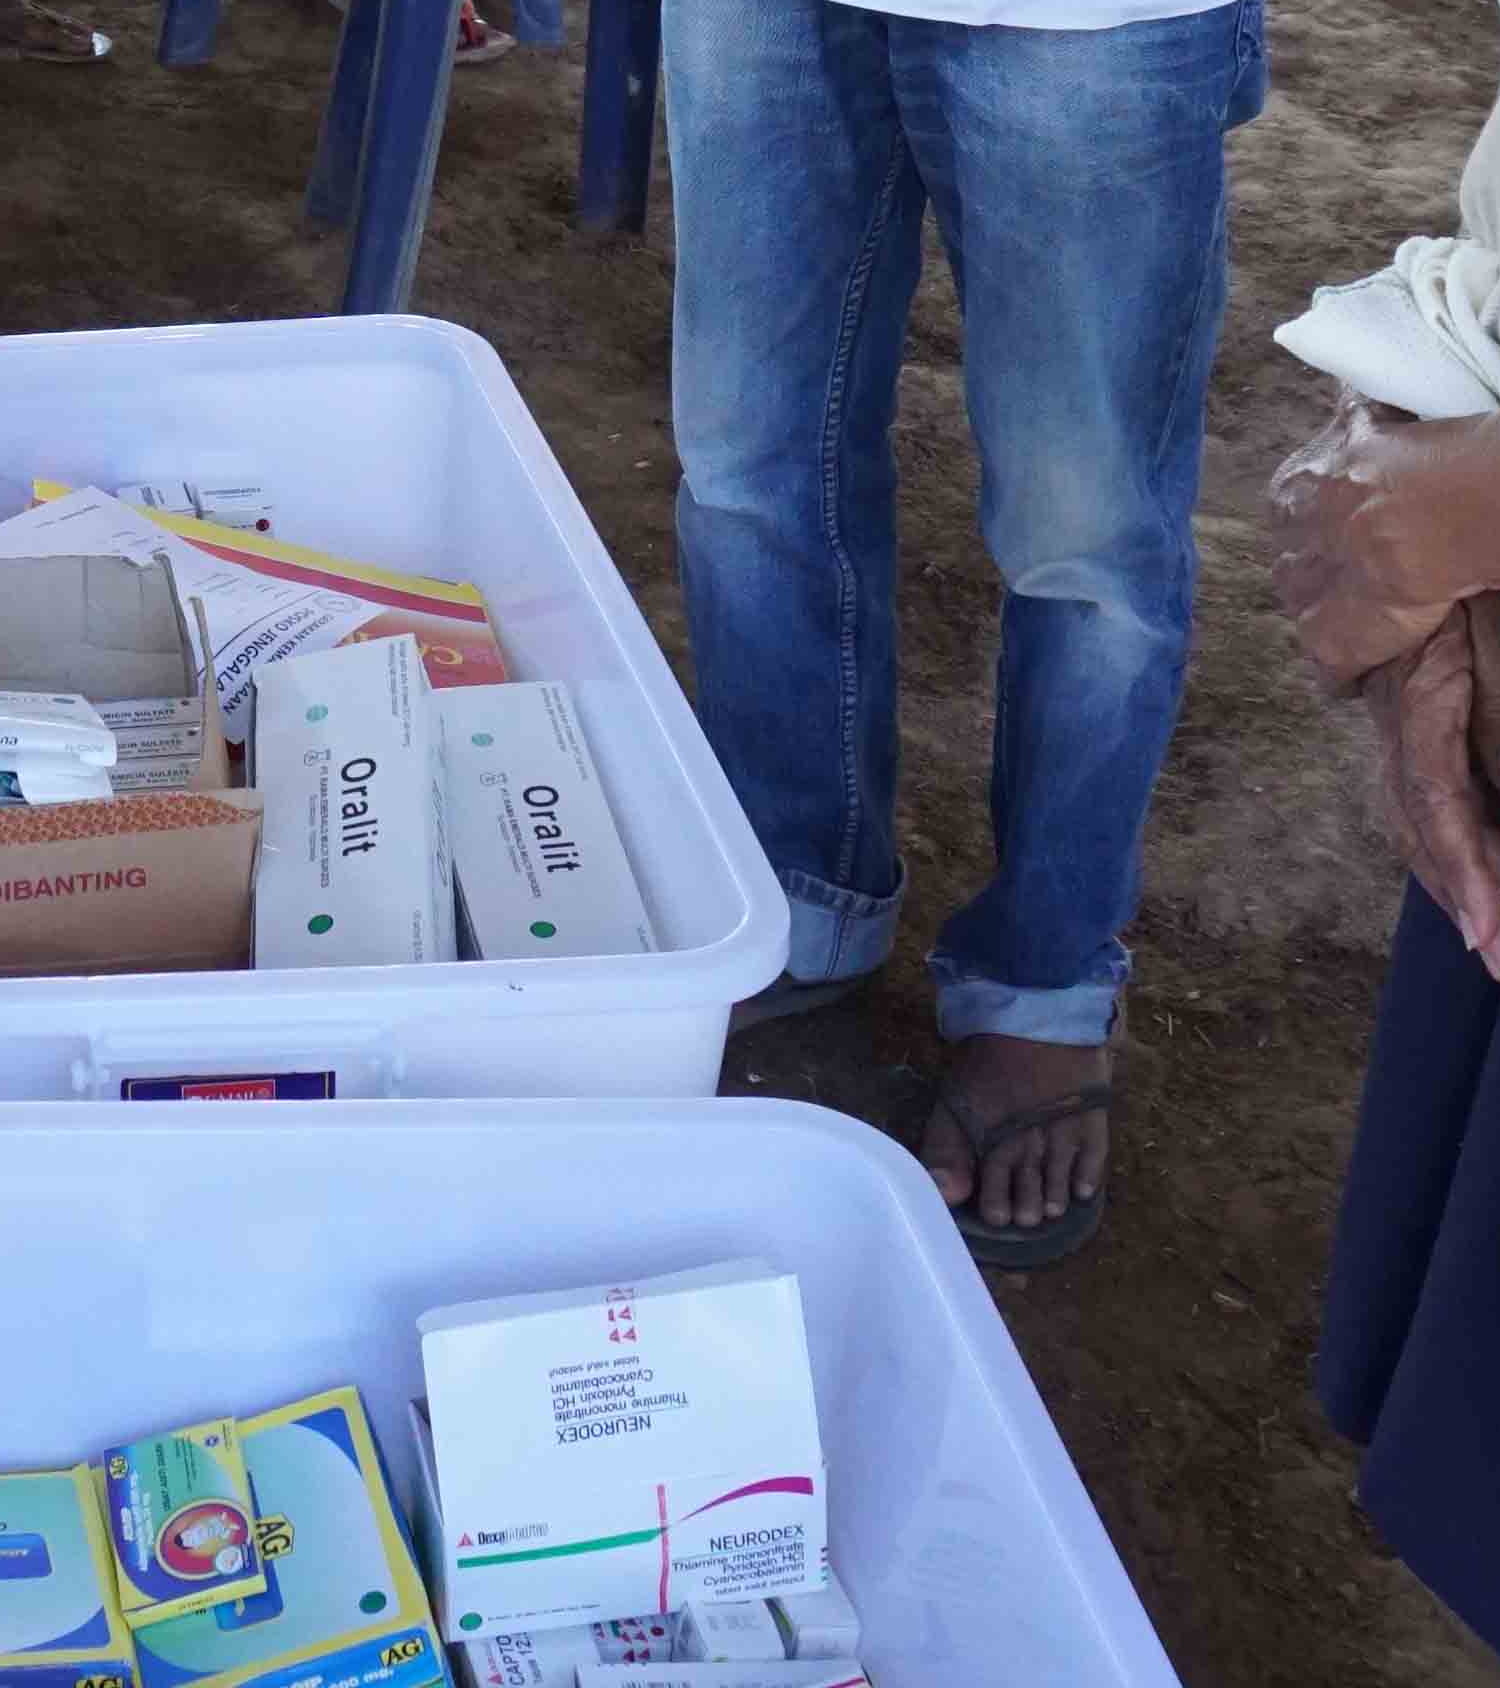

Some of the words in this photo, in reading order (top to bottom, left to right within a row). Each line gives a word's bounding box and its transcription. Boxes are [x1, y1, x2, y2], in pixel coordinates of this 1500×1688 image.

[216, 628, 278, 693] JENGGALA
[341, 758, 378, 856] Oralit
[523, 785, 582, 873] Oralit
[551, 1369, 654, 1394] Cyanocobalamin
[631, 1392, 689, 1406] Thiamine
[556, 1415, 652, 1445] NEURODEX
[709, 1523, 805, 1553] NEURODEX
[384, 1639, 422, 1667] AG
